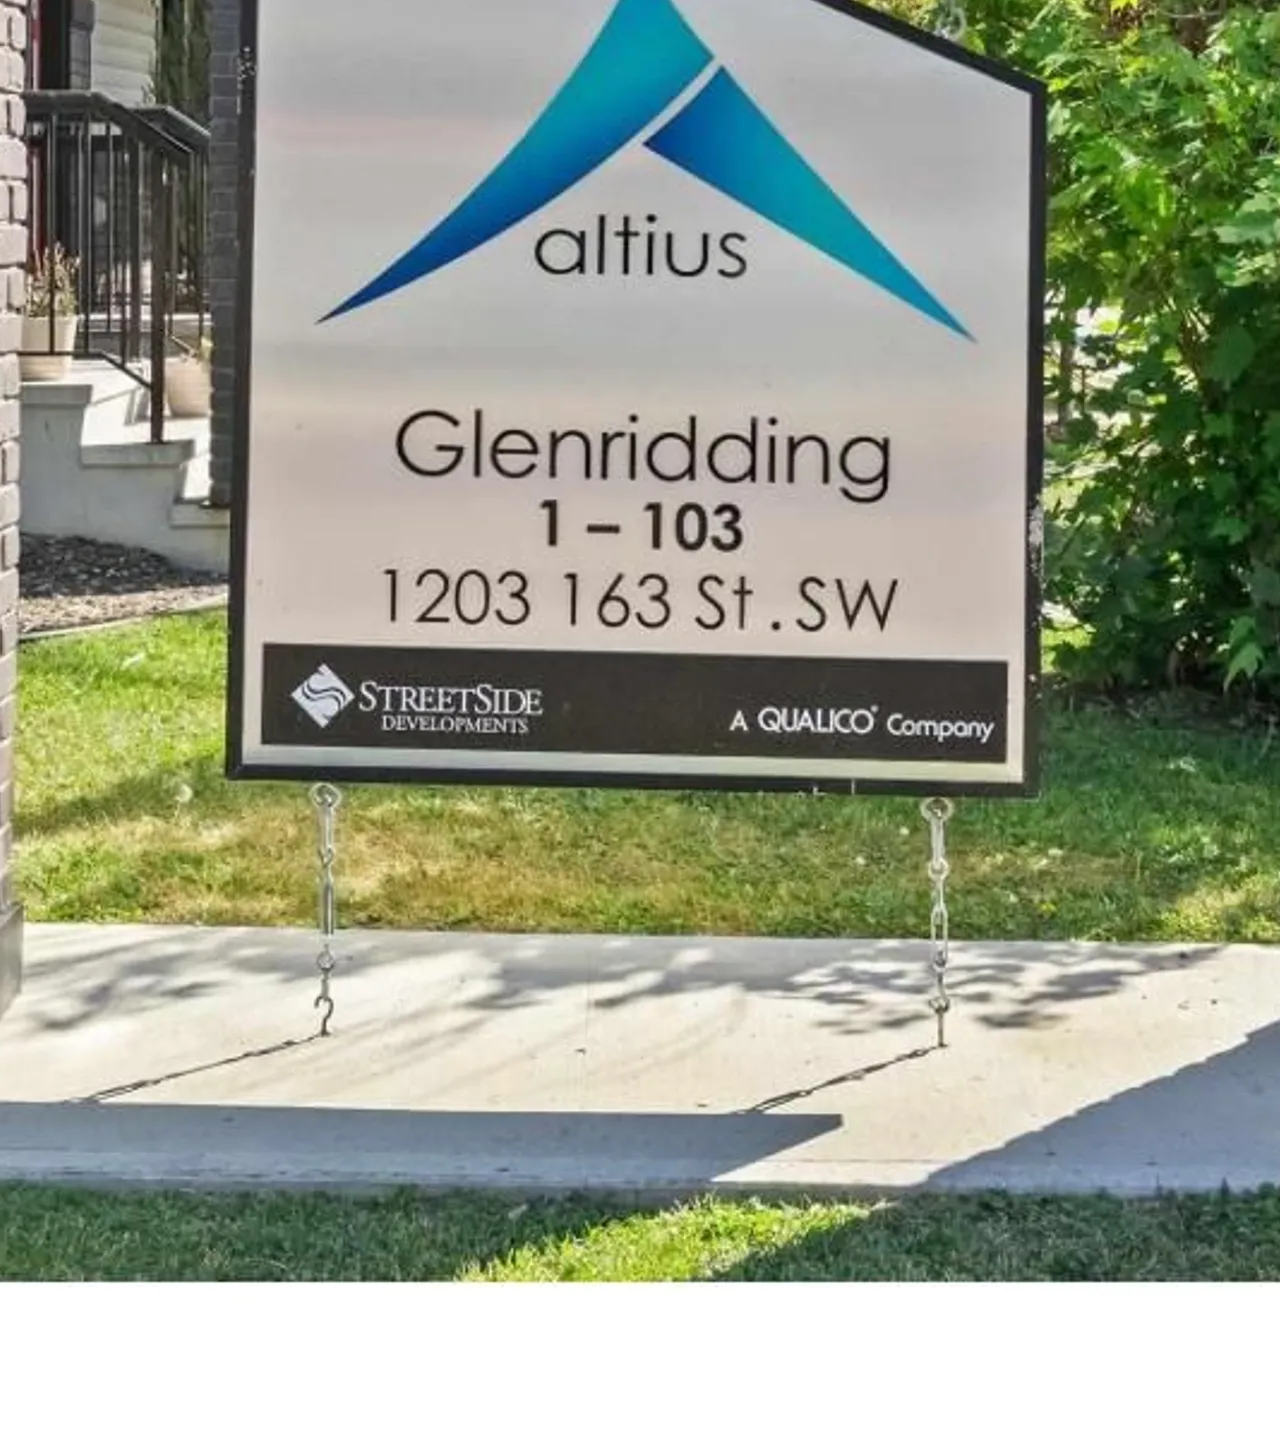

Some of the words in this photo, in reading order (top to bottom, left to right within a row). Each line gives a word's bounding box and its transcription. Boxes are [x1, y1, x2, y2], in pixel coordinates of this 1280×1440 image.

[534, 213, 748, 279] altius
[395, 408, 892, 505] Glenridding
[540, 499, 558, 547] 1
[644, 502, 744, 553] 103
[383, 568, 531, 626] 1203
[564, 572, 671, 629] 163
[382, 714, 529, 734] DEVELOPMENTS
[729, 710, 749, 732] A
[886, 713, 995, 744] Company
